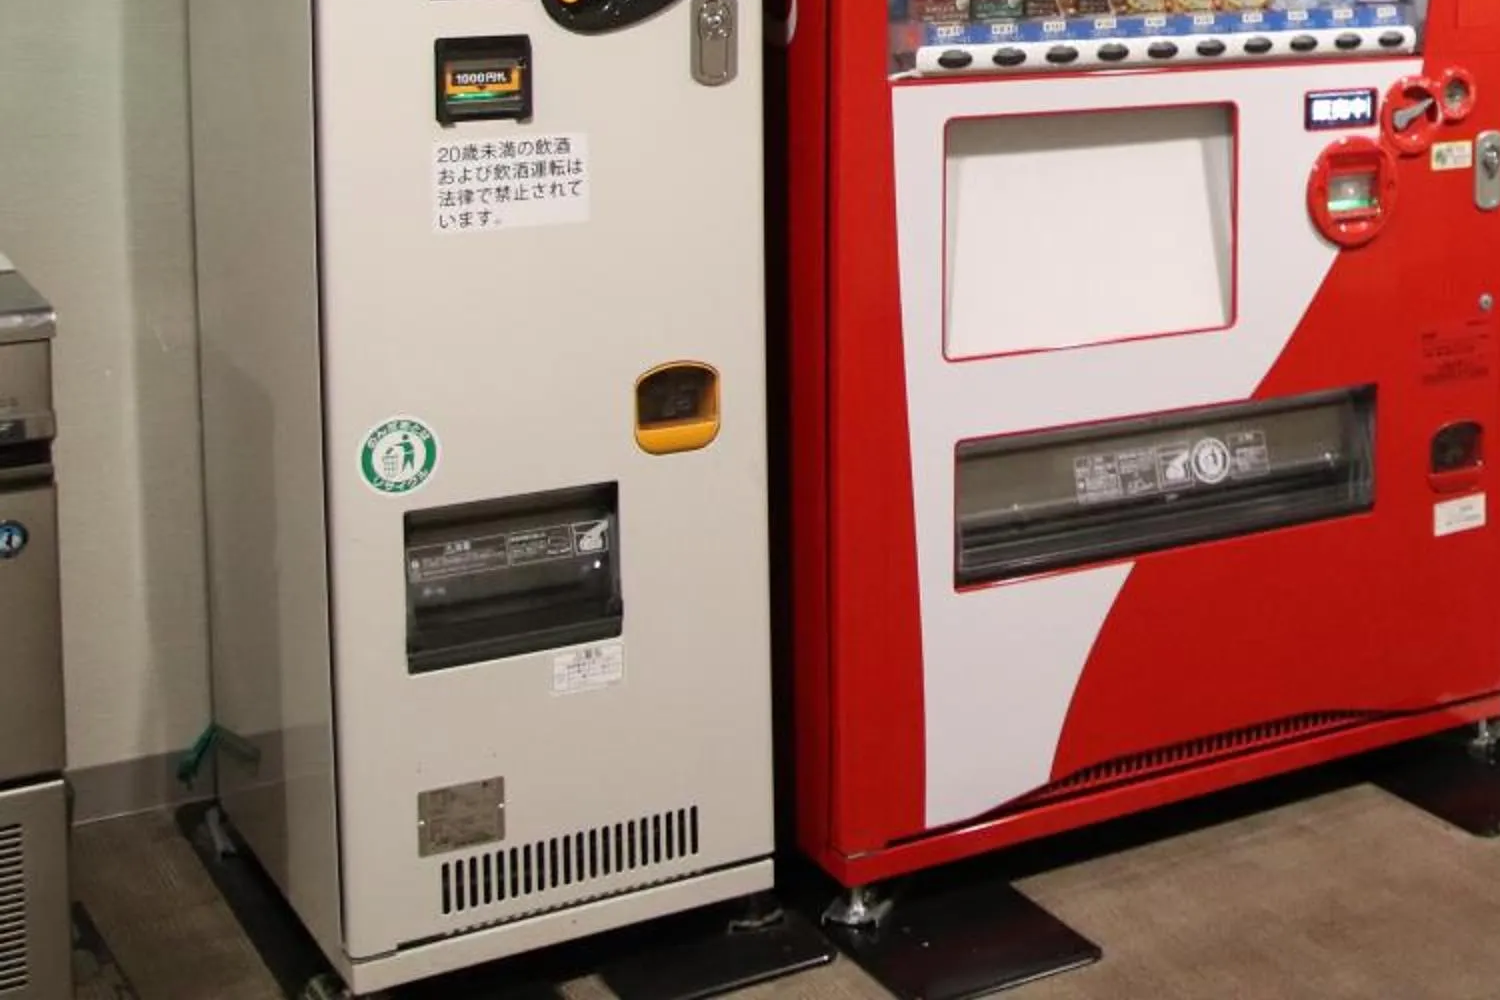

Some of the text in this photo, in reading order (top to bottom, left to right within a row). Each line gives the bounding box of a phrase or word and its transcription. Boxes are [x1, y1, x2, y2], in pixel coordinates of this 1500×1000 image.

[437, 137, 572, 163] 20歳未満の飲酒
[437, 158, 584, 185] および飲酒運転は
[438, 180, 583, 208] 法律で禁止されて
[438, 208, 502, 230] います。
